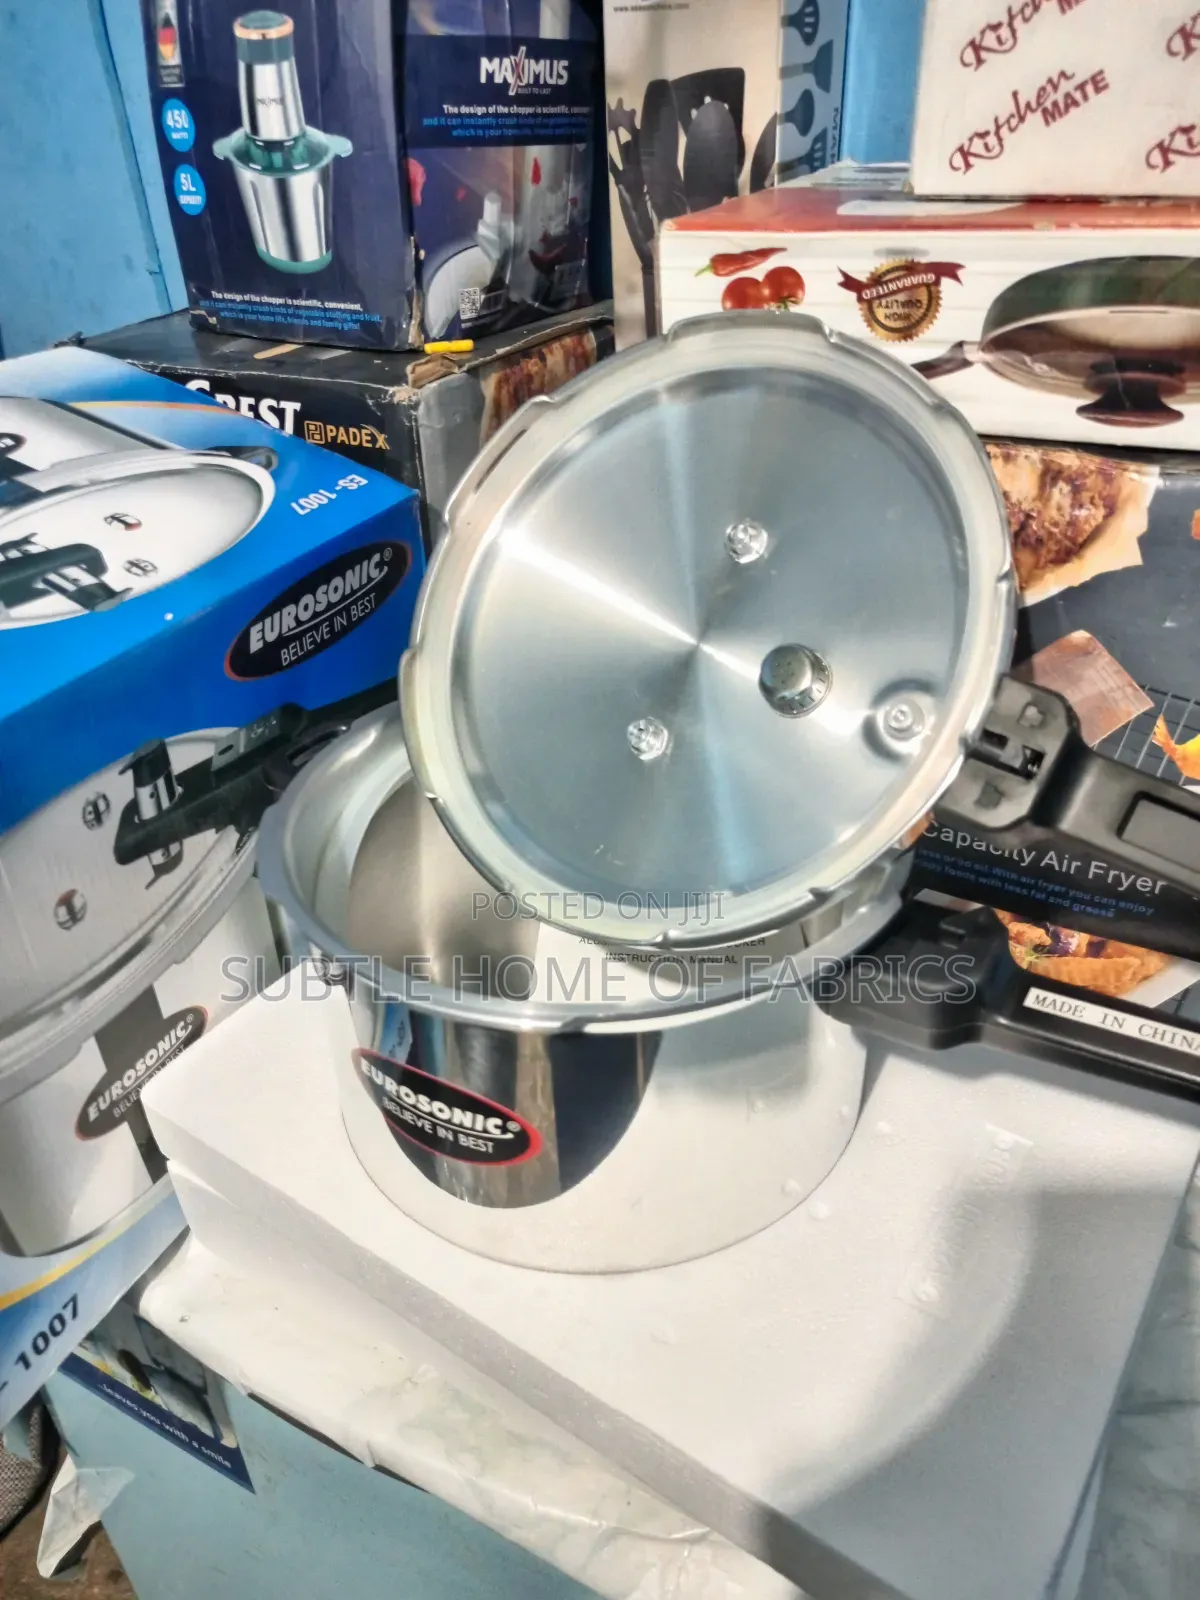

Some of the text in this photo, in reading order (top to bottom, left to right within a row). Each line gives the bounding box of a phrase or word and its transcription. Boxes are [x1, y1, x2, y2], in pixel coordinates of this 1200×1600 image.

[480, 46, 568, 96] MAXIMUS
[442, 104, 458, 114] The
[460, 104, 487, 115] design
[488, 104, 496, 114] of
[497, 104, 509, 114] the
[510, 105, 536, 116] chopper
[1041, 69, 1110, 127] MATE
[423, 117, 439, 126] and
[446, 117, 461, 126] can
[463, 117, 497, 127] instantly
[949, 69, 1076, 175] Kitchen
[211, 290, 223, 299] The
[861, 272, 936, 300] GUARANTEED
[876, 299, 924, 310] QUALITY
[185, 379, 301, 435] EST
[325, 423, 390, 450] PADEX
[291, 489, 337, 516] 1007
[281, 592, 377, 667] BELIEVE IN BEST
[1040, 850, 1081, 875] Air
[1088, 861, 1168, 896] Fryer
[1033, 994, 1087, 1019] MADE
[1099, 1012, 1127, 1030] IN
[382, 1096, 495, 1154] BELIEVE IN BEST
[14, 1291, 79, 1372] 1007
[162, 1422, 190, 1442] with
[200, 1446, 232, 1469] smile
